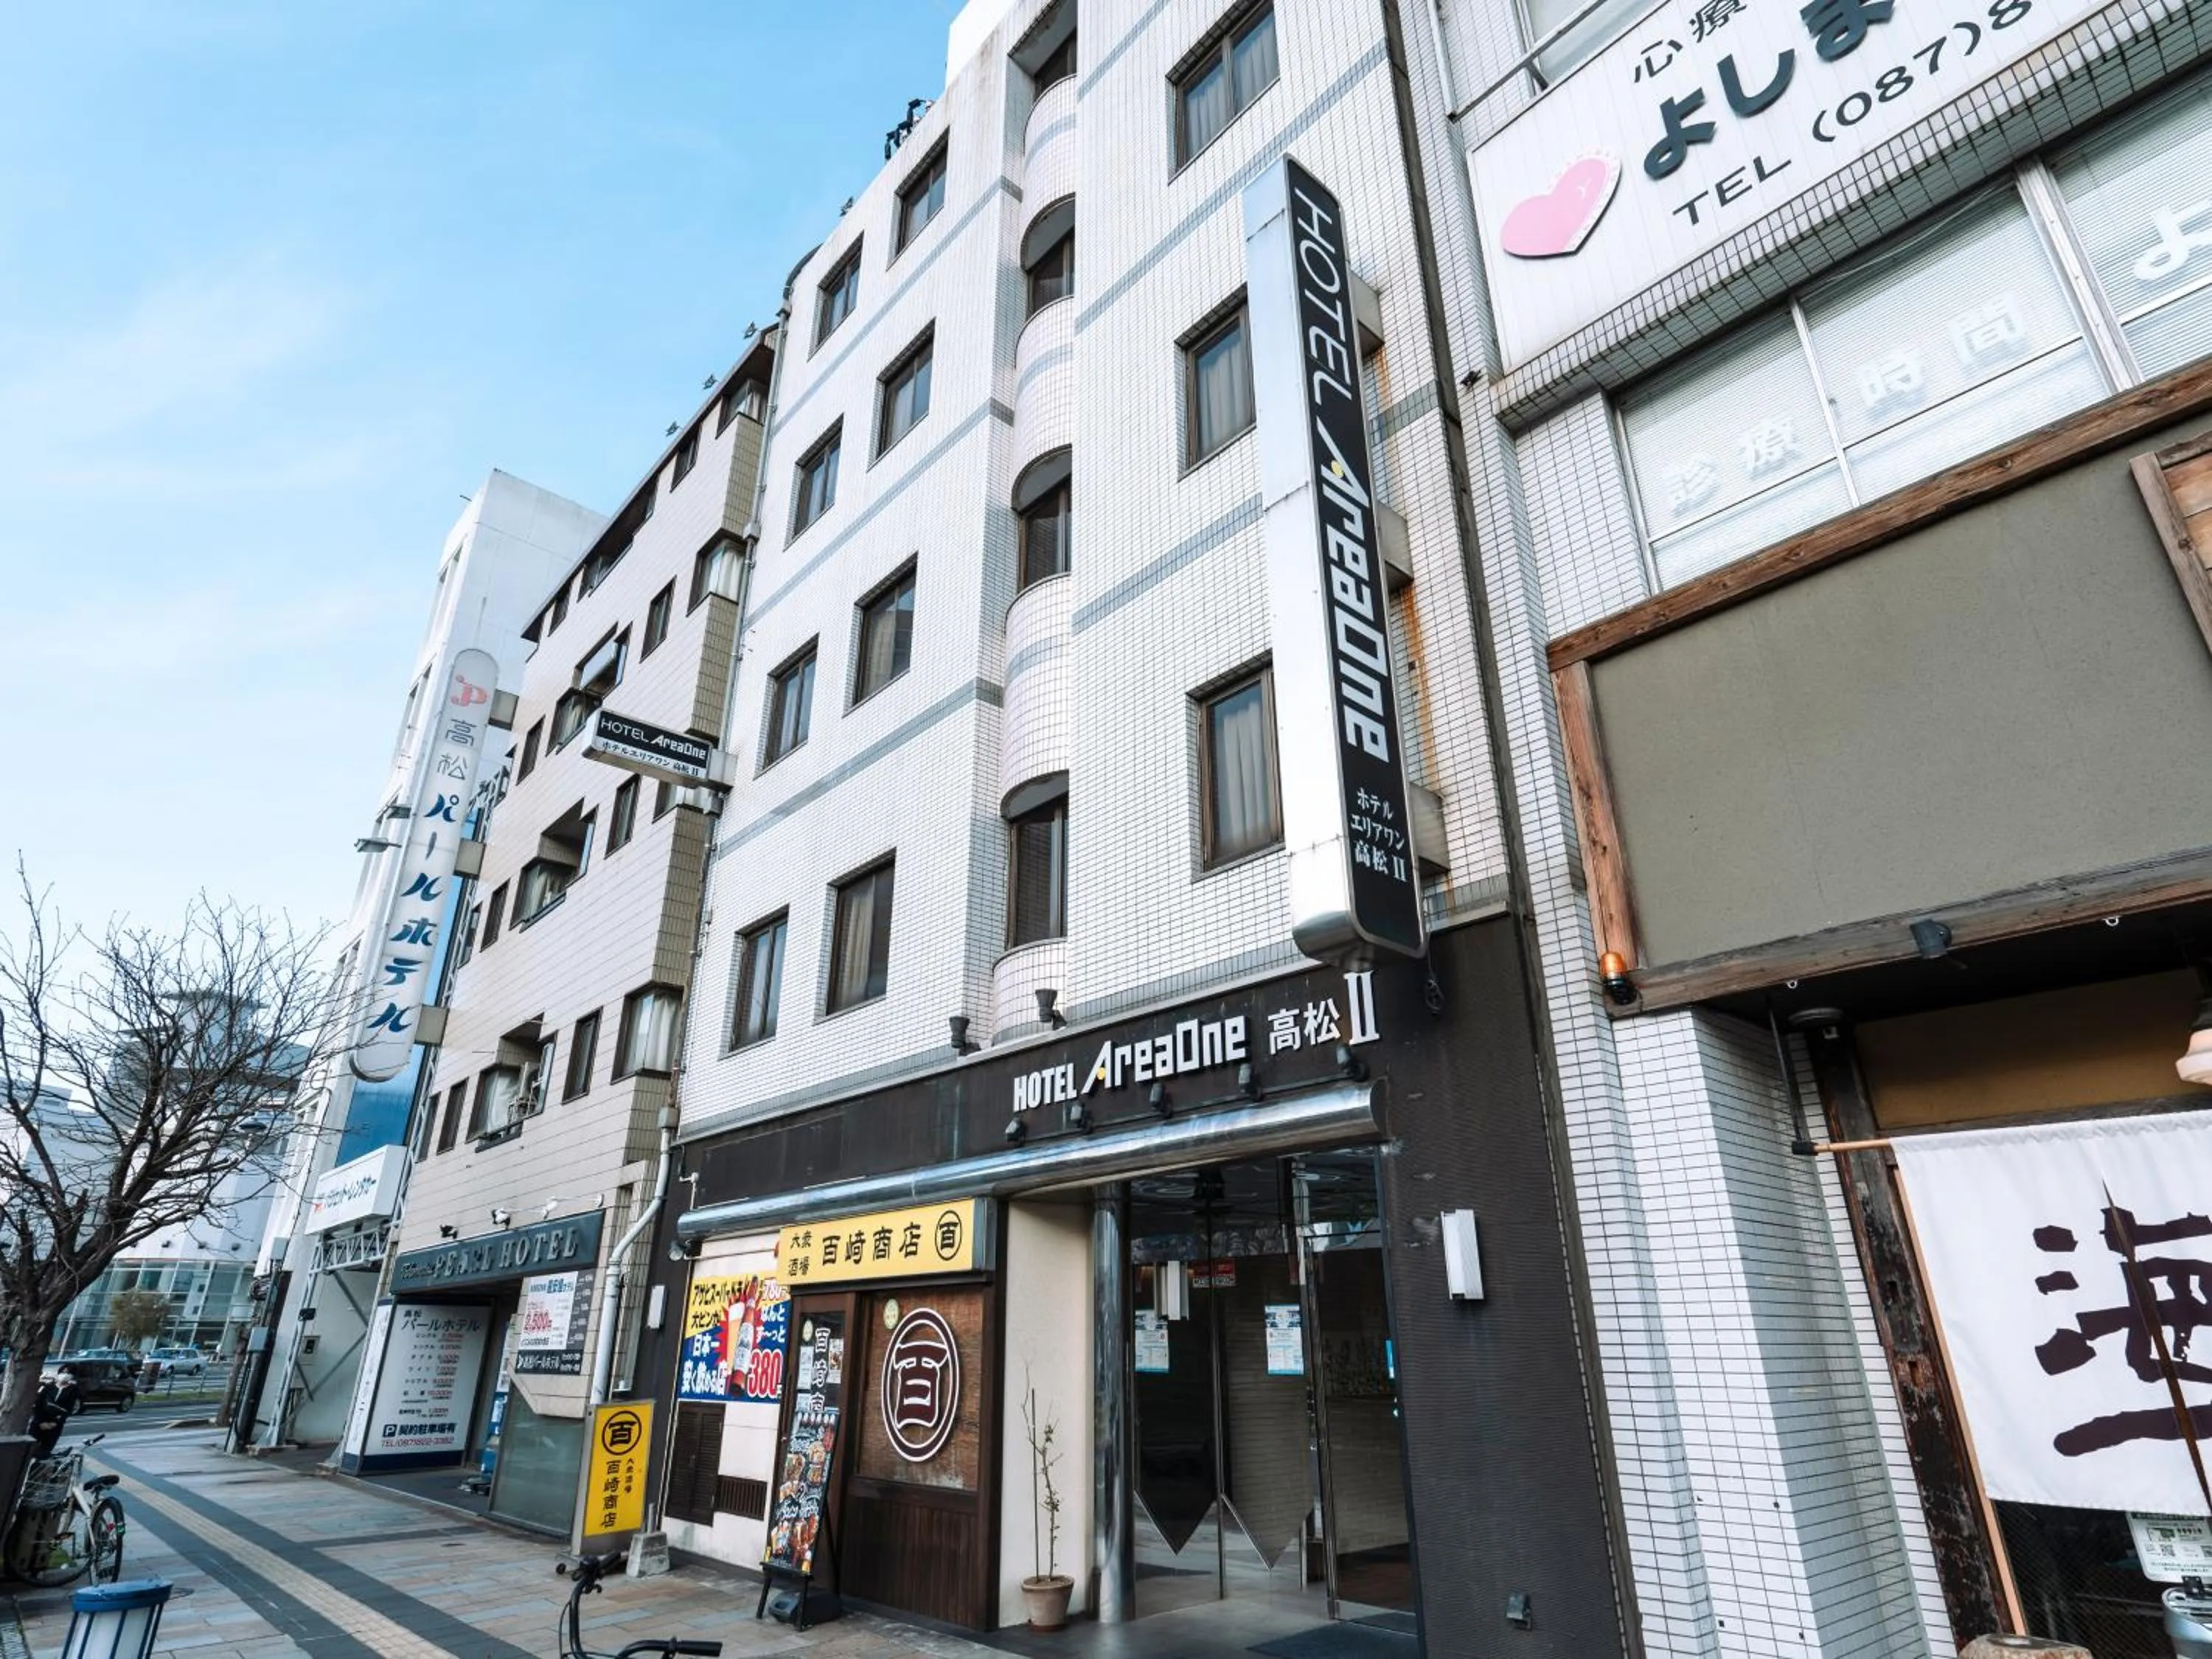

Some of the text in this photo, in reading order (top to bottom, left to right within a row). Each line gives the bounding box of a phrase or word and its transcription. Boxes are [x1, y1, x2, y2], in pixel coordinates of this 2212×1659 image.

[1672, 156, 1792, 226] TEL
[1295, 187, 1390, 764] HOTEL AreaOne
[601, 717, 706, 760] HOTEL AreaOne
[1356, 786, 1394, 820] ホテル
[1350, 814, 1405, 851] エリアワン
[1013, 1062, 1077, 1112] HOTEL
[1082, 1016, 1246, 1094] AreaOne
[498, 1227, 579, 1268] HOTEL
[790, 1231, 813, 1250] 大衆
[788, 1256, 810, 1276] 酒場
[401, 1318, 481, 1332] パールホテル
[692, 1333, 720, 1357] 日本一
